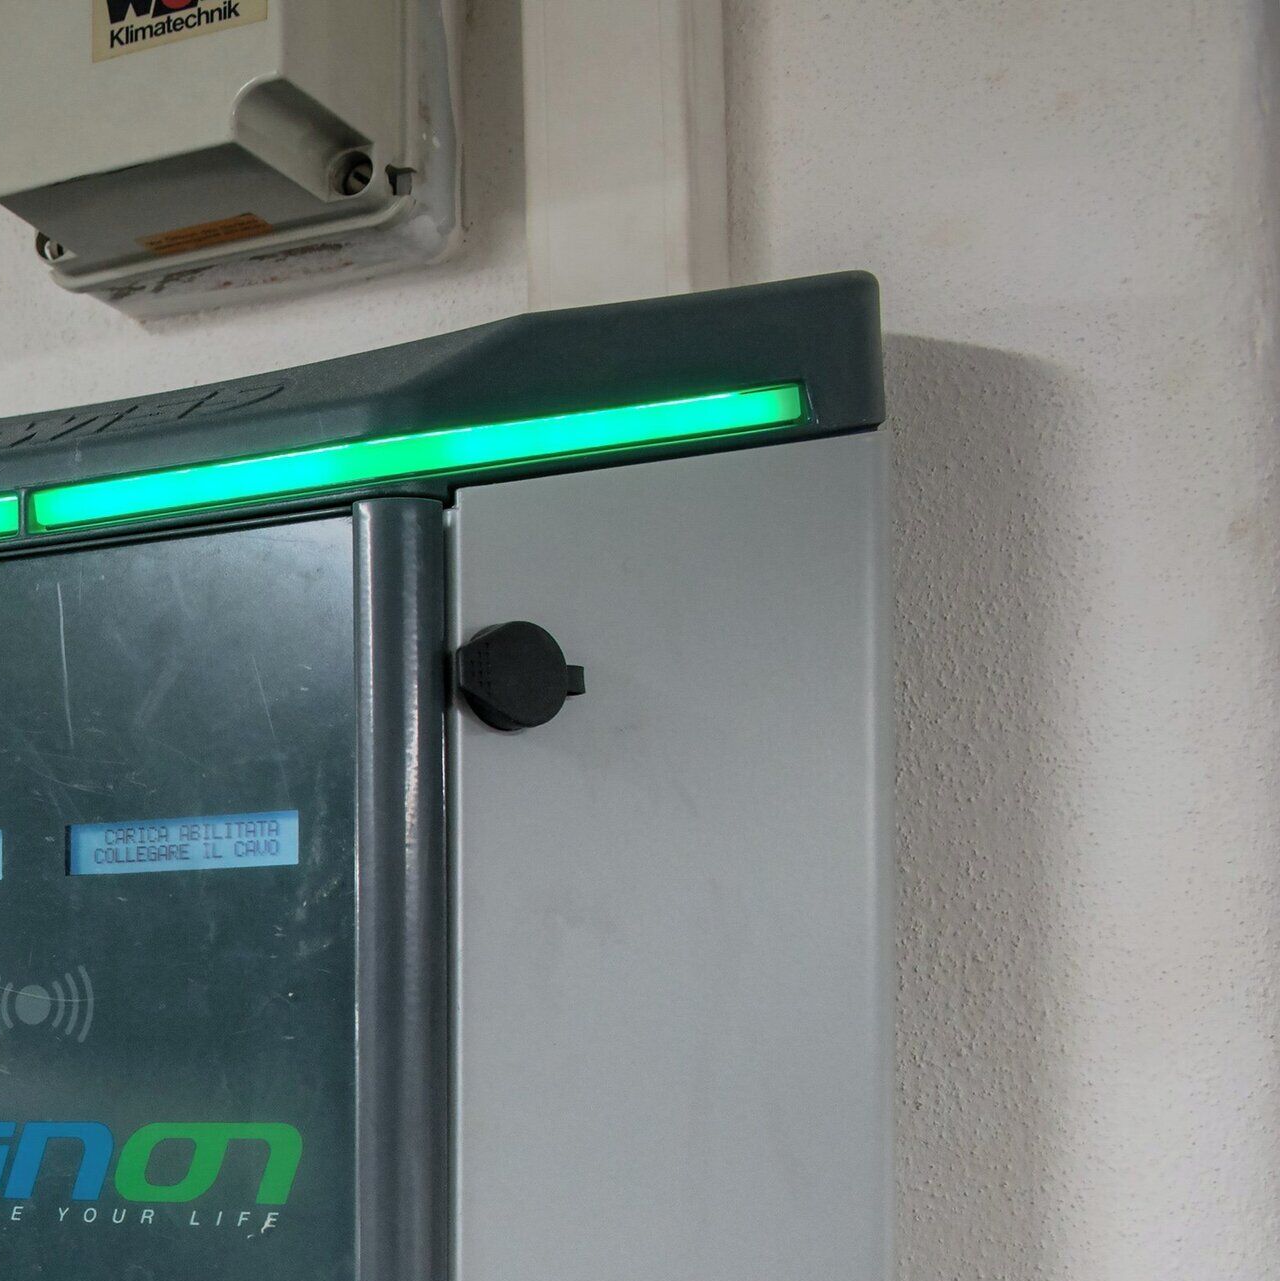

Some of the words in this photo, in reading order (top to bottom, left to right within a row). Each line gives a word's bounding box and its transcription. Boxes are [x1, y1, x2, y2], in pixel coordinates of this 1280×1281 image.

[109, 2, 241, 48] Klimatechnik
[104, 826, 169, 845] CARICA
[179, 820, 279, 842] ABILITATA
[94, 844, 190, 865] COLLEGARE
[203, 842, 223, 860] IL
[233, 839, 279, 858] CAVO
[57, 1206, 155, 1226] YOUR
[190, 1209, 280, 1229] LIFE
